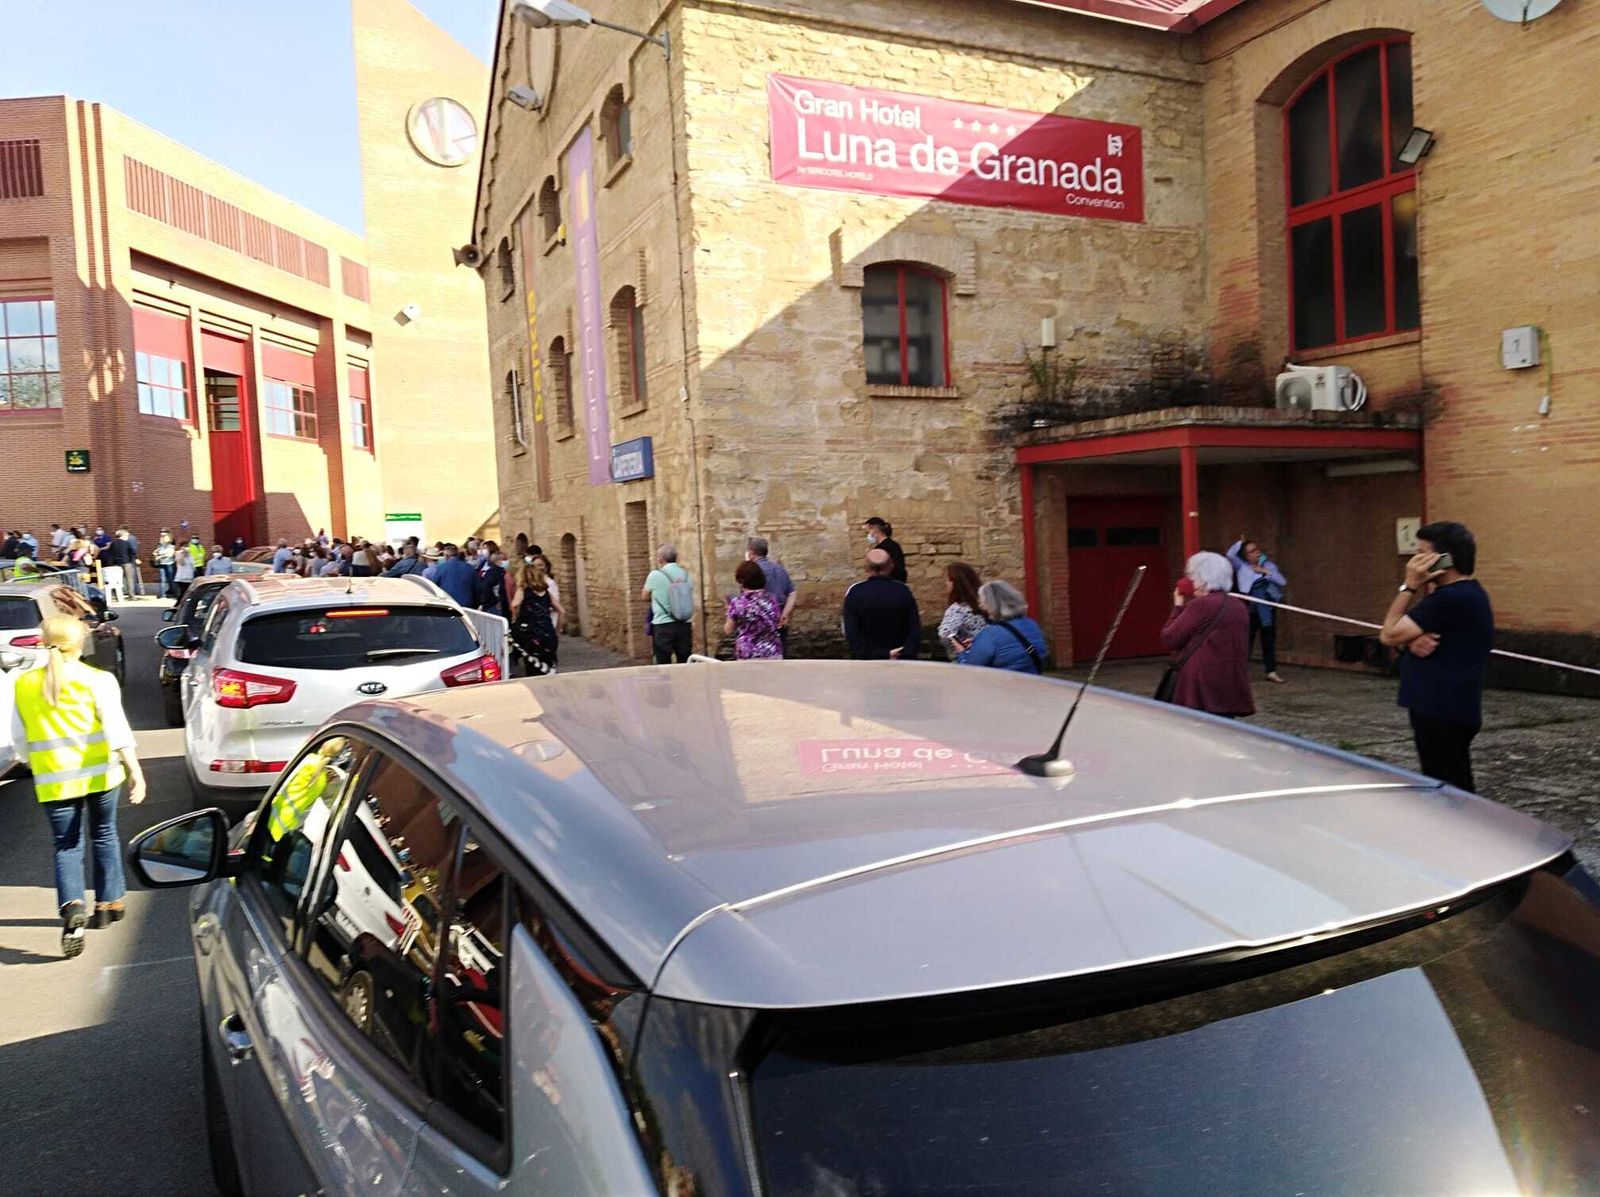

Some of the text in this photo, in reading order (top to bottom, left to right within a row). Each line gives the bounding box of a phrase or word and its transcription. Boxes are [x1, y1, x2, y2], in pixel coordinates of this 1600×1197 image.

[794, 89, 921, 129] Gran Hotel
[797, 117, 1125, 195] Luna de Granada
[1065, 193, 1125, 210] Convention
